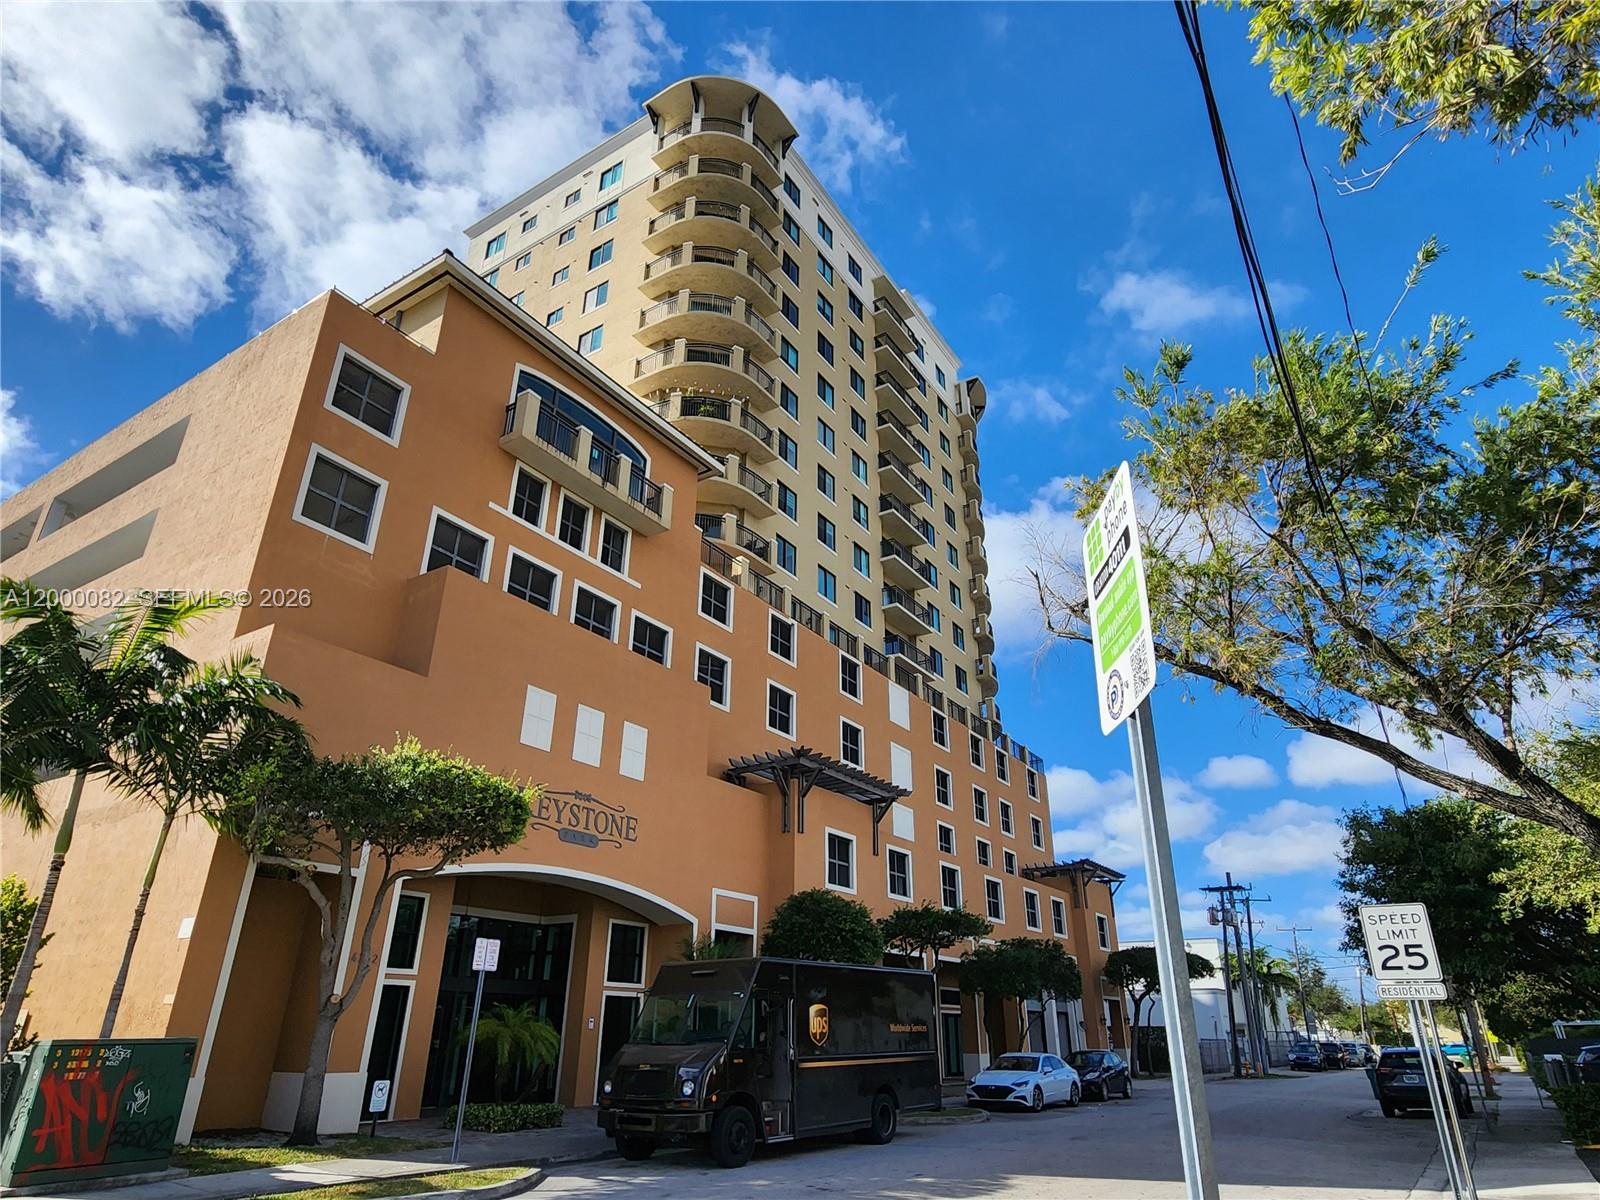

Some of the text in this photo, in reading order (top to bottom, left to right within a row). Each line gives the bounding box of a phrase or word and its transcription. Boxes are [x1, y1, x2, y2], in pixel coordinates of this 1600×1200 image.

[529, 792, 638, 842] EYSTONE
[1367, 912, 1422, 926] SPEED
[1376, 928, 1418, 941] LIMIT
[1377, 944, 1429, 971] 25
[1381, 987, 1443, 996] RESIDENTIAL
[811, 1016, 828, 1039] ups
